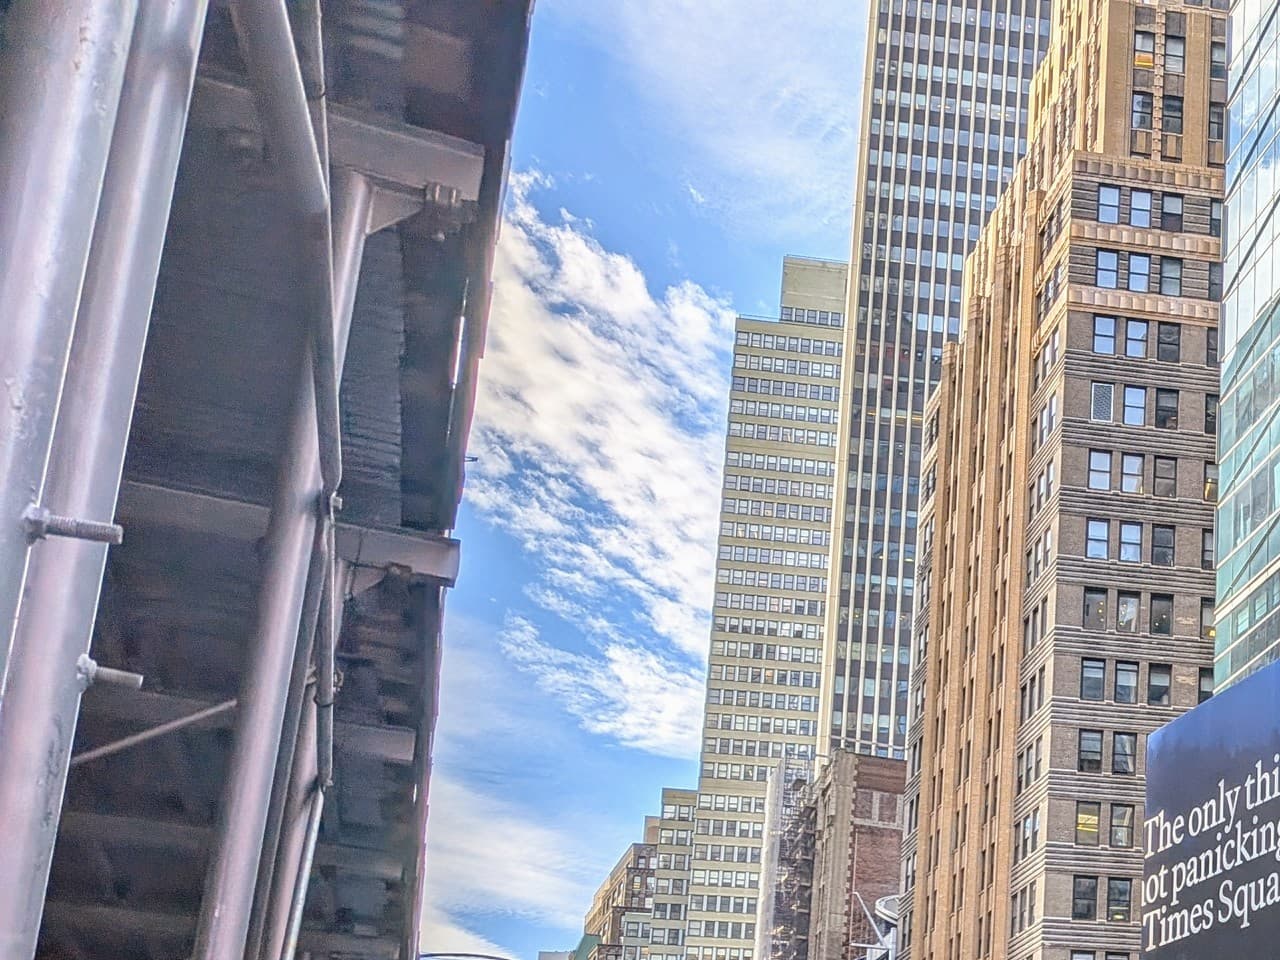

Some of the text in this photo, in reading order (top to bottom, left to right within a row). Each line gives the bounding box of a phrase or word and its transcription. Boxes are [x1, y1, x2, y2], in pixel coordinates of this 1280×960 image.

[1144, 809, 1184, 859] The
[1188, 779, 1241, 835] only
[1143, 898, 1213, 952] Times
